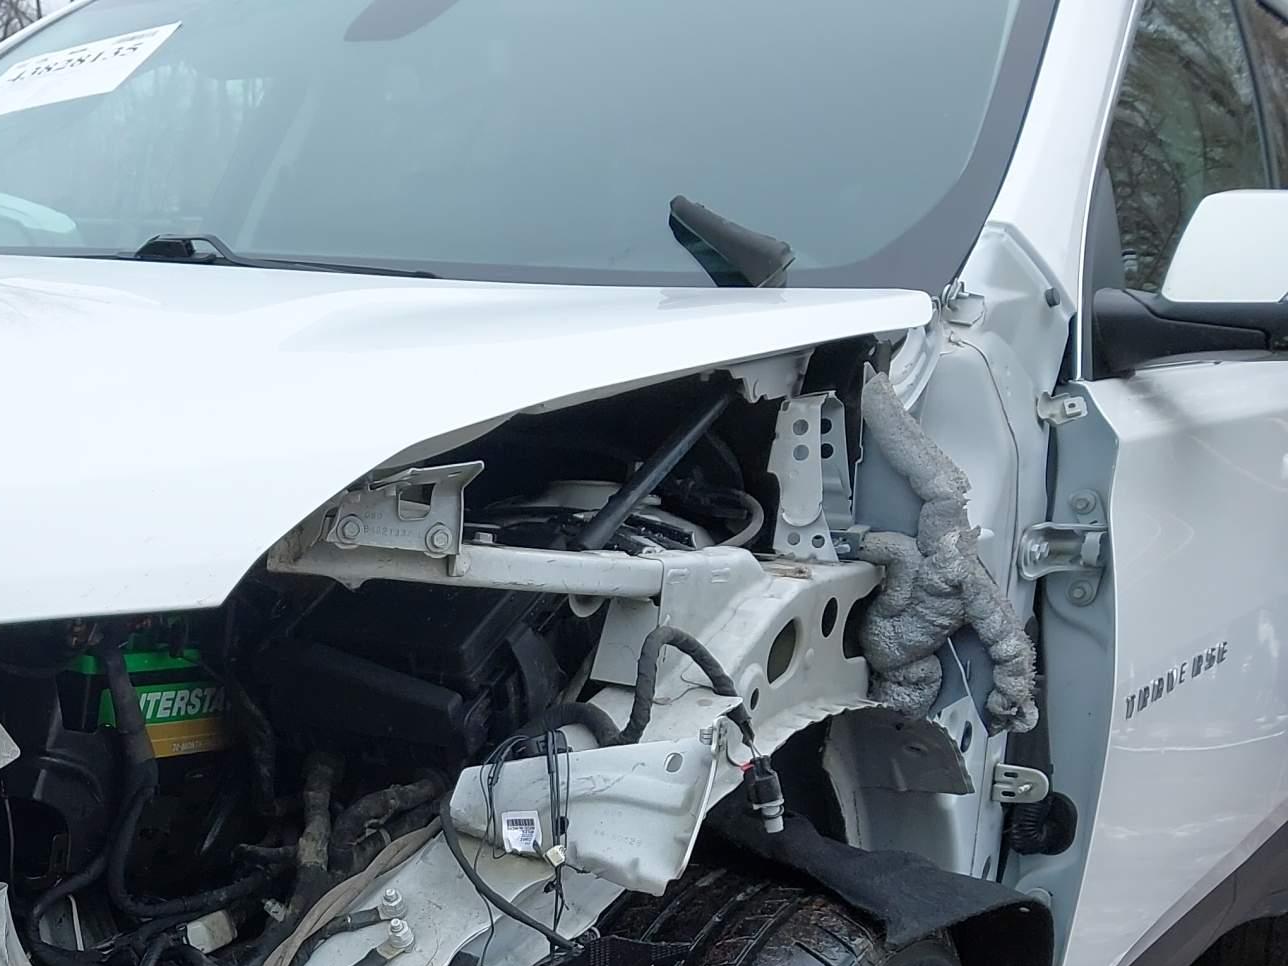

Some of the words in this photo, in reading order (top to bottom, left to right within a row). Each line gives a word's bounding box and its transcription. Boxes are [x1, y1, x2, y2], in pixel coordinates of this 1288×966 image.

[7, 42, 145, 82] 43828135
[1125, 640, 1228, 720] TRAVERSE
[139, 687, 227, 720] TERSTA
